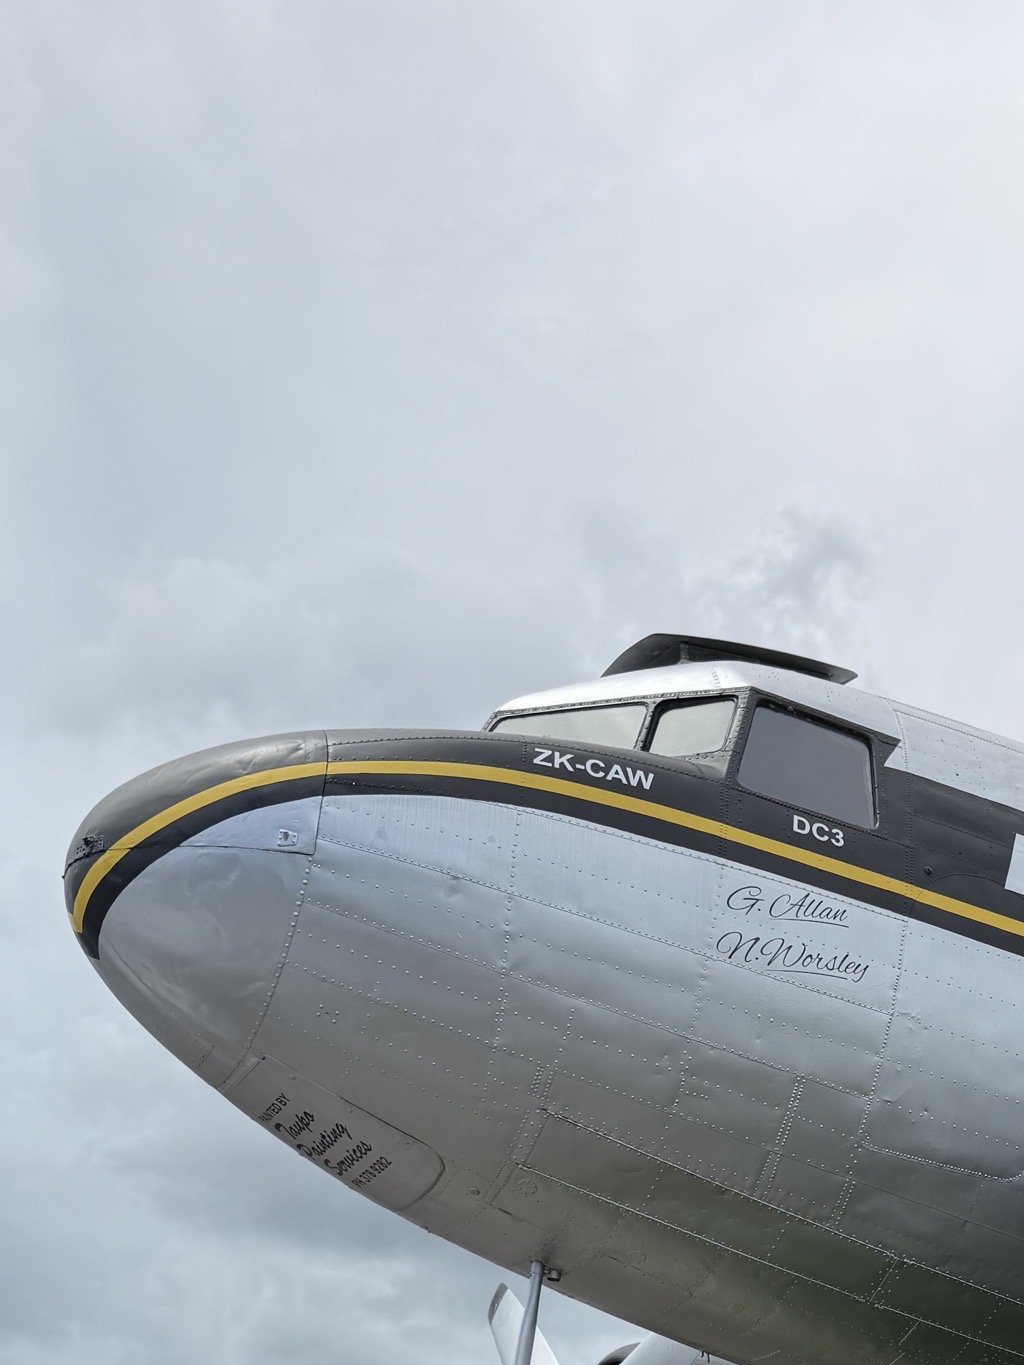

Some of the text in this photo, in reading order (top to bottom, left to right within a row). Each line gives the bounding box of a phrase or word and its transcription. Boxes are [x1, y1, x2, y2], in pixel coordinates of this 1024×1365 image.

[533, 748, 654, 790] ZK-CAW
[792, 815, 845, 847] DC3
[726, 885, 849, 921] G. Allan
[275, 1092, 290, 1107] BY
[275, 1110, 315, 1140] Taupo
[296, 1122, 353, 1161] Painting
[324, 1141, 373, 1176] Services
